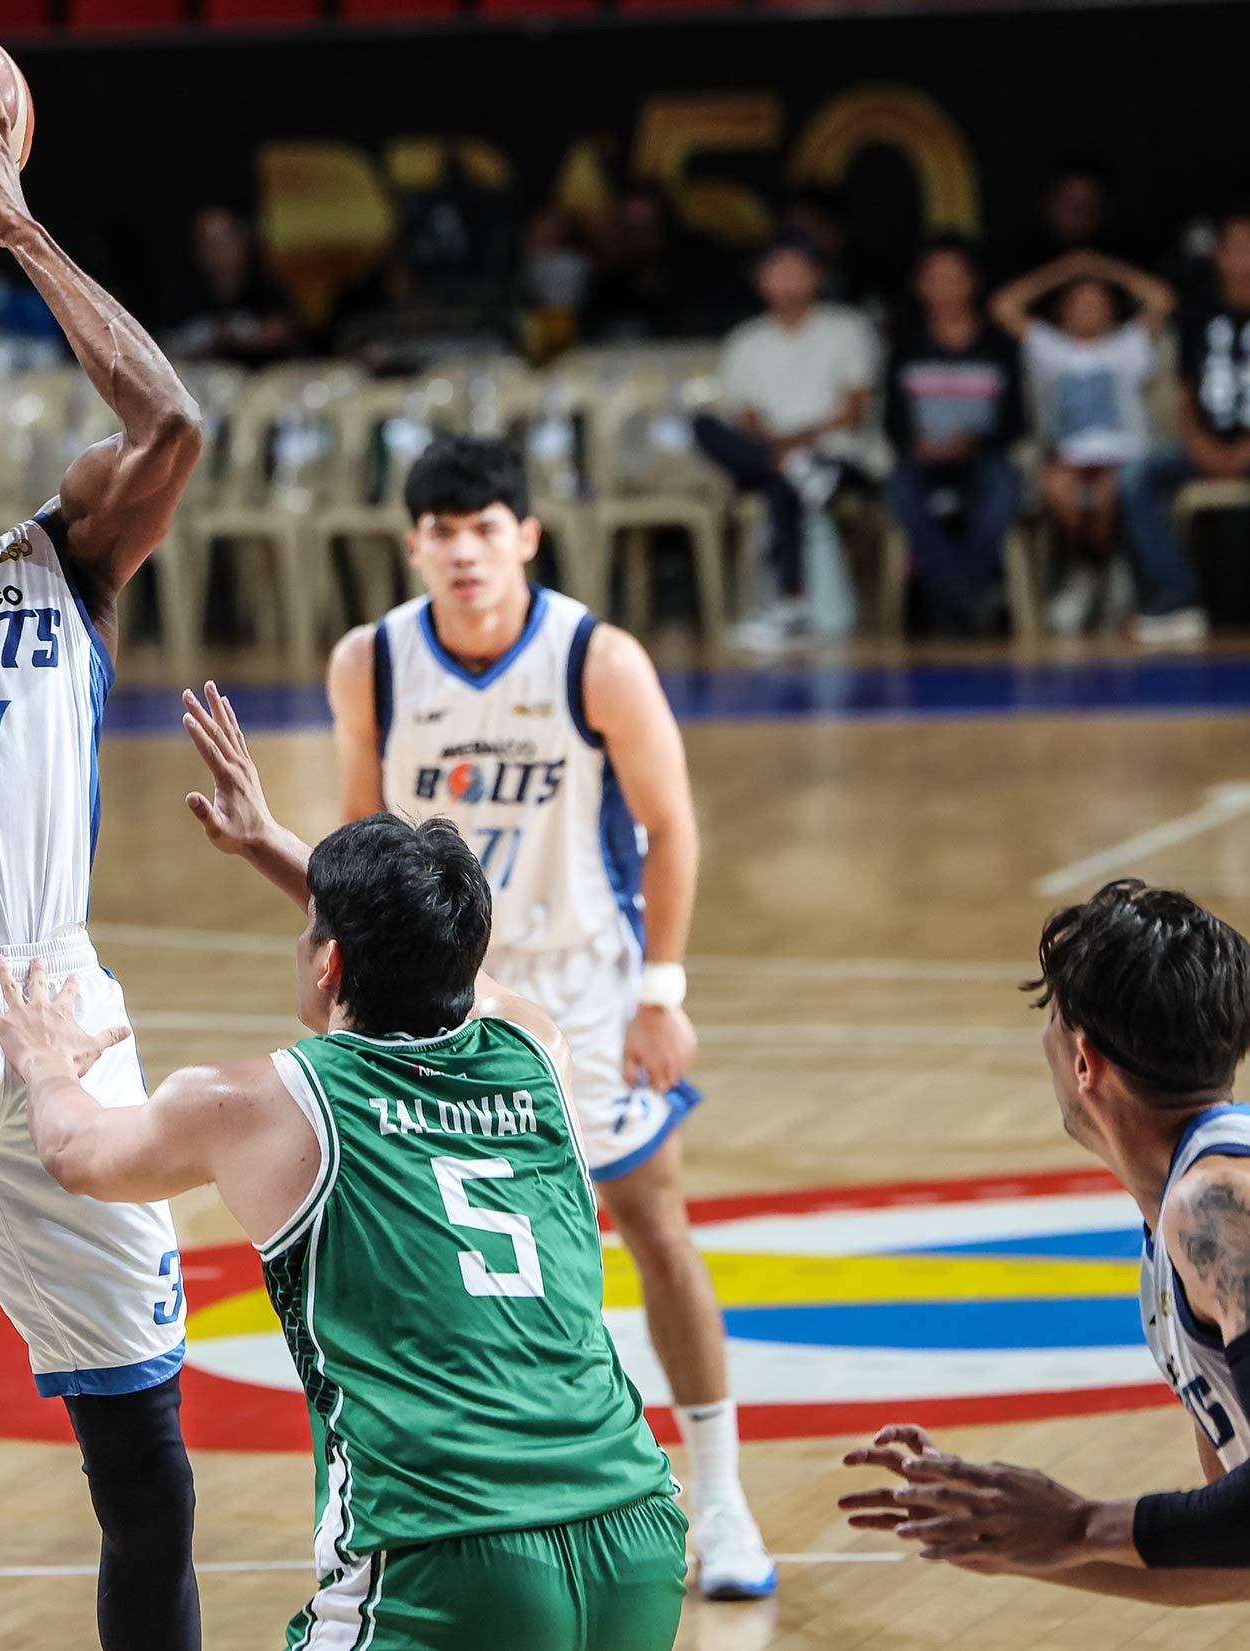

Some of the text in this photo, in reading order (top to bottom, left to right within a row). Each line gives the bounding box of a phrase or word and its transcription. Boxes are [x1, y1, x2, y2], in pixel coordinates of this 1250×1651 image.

[368, 1089, 538, 1137] ZALDIVAR
[430, 1157, 545, 1297] 5
[154, 1249, 182, 1326] 3
